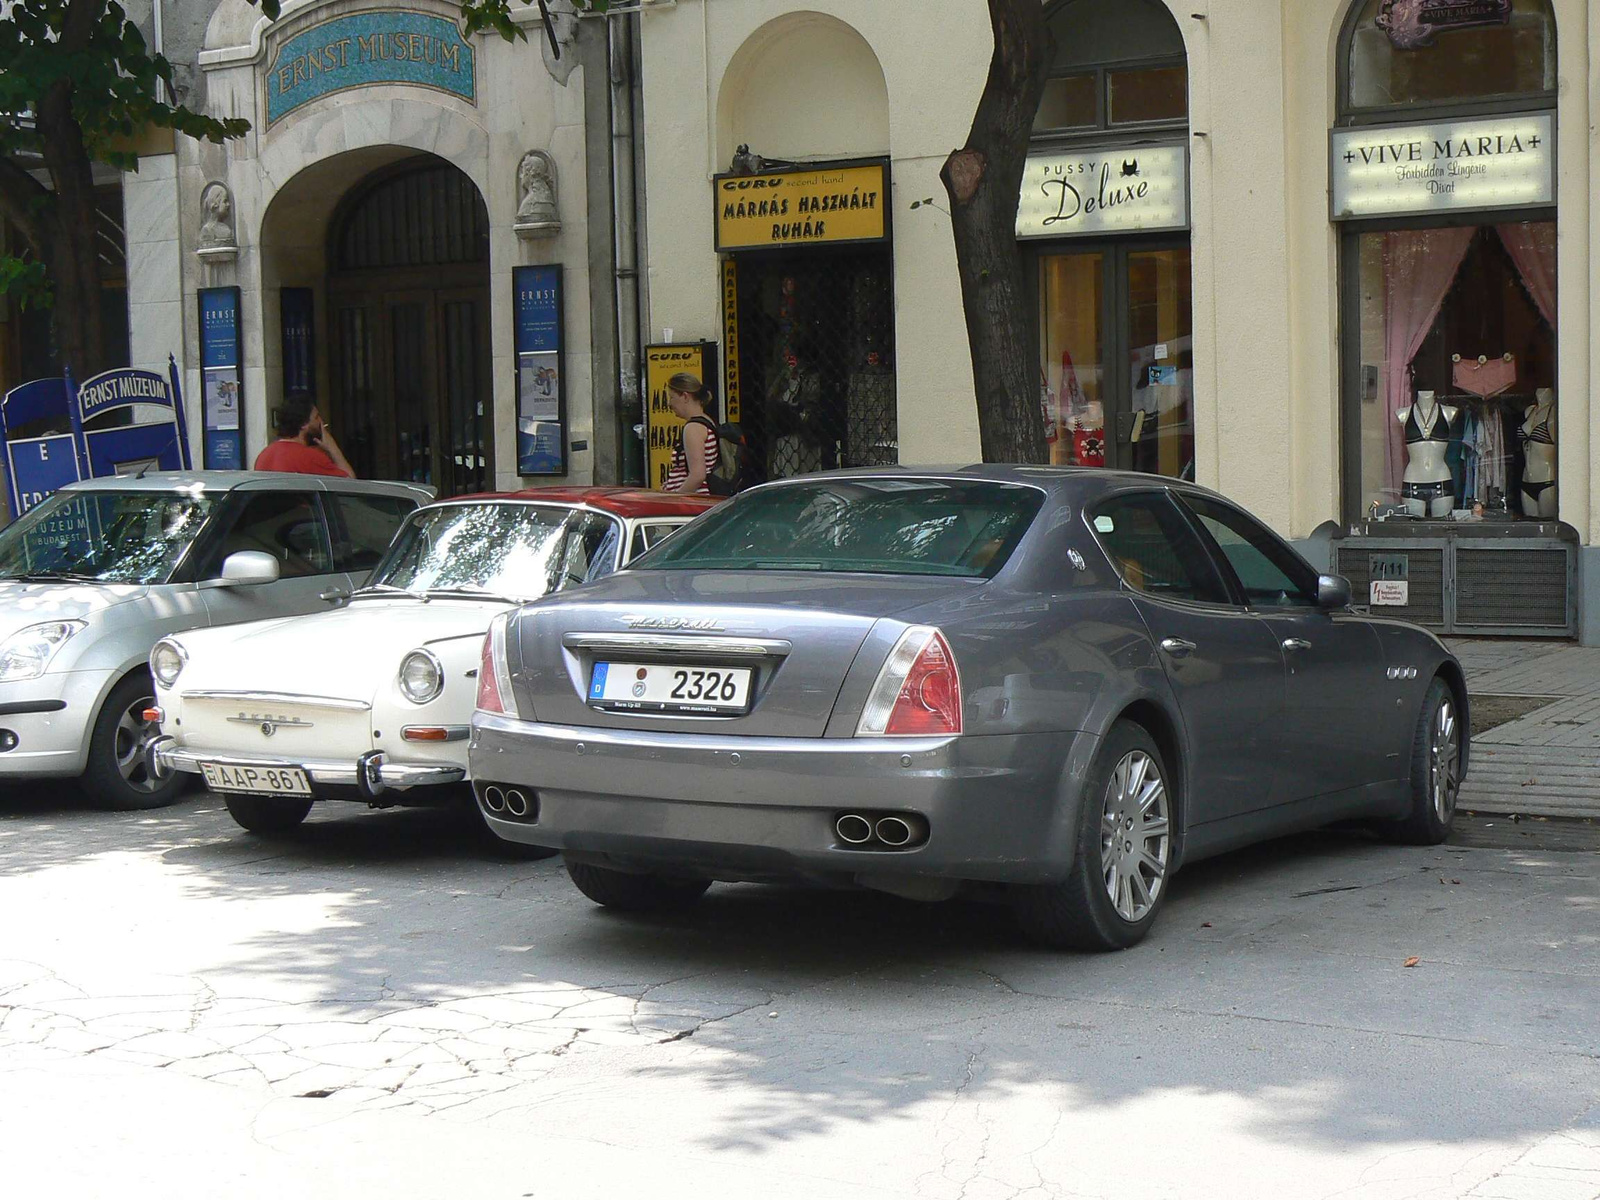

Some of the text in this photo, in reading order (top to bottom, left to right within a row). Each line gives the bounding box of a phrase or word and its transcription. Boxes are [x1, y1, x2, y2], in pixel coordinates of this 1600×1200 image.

[277, 32, 461, 95] ERNST MUSEUM
[1358, 134, 1525, 165] VIVE MARIA
[786, 176, 818, 187] second
[821, 173, 844, 185] hand
[1044, 162, 1096, 176] PUSSY
[1395, 160, 1487, 181] Forbidden Lingerie
[1041, 162, 1149, 226] Deluxe
[1426, 180, 1455, 194] Divat
[723, 187, 877, 220] MÁRKÁS HASZNÁLT
[771, 215, 826, 241] RUHÁK
[521, 289, 555, 300] ERNST
[206, 309, 235, 320] ERNST
[84, 373, 166, 410] ERNST MÚZEUM
[594, 670, 737, 701] D 2326
[220, 767, 306, 790] AAP-861
